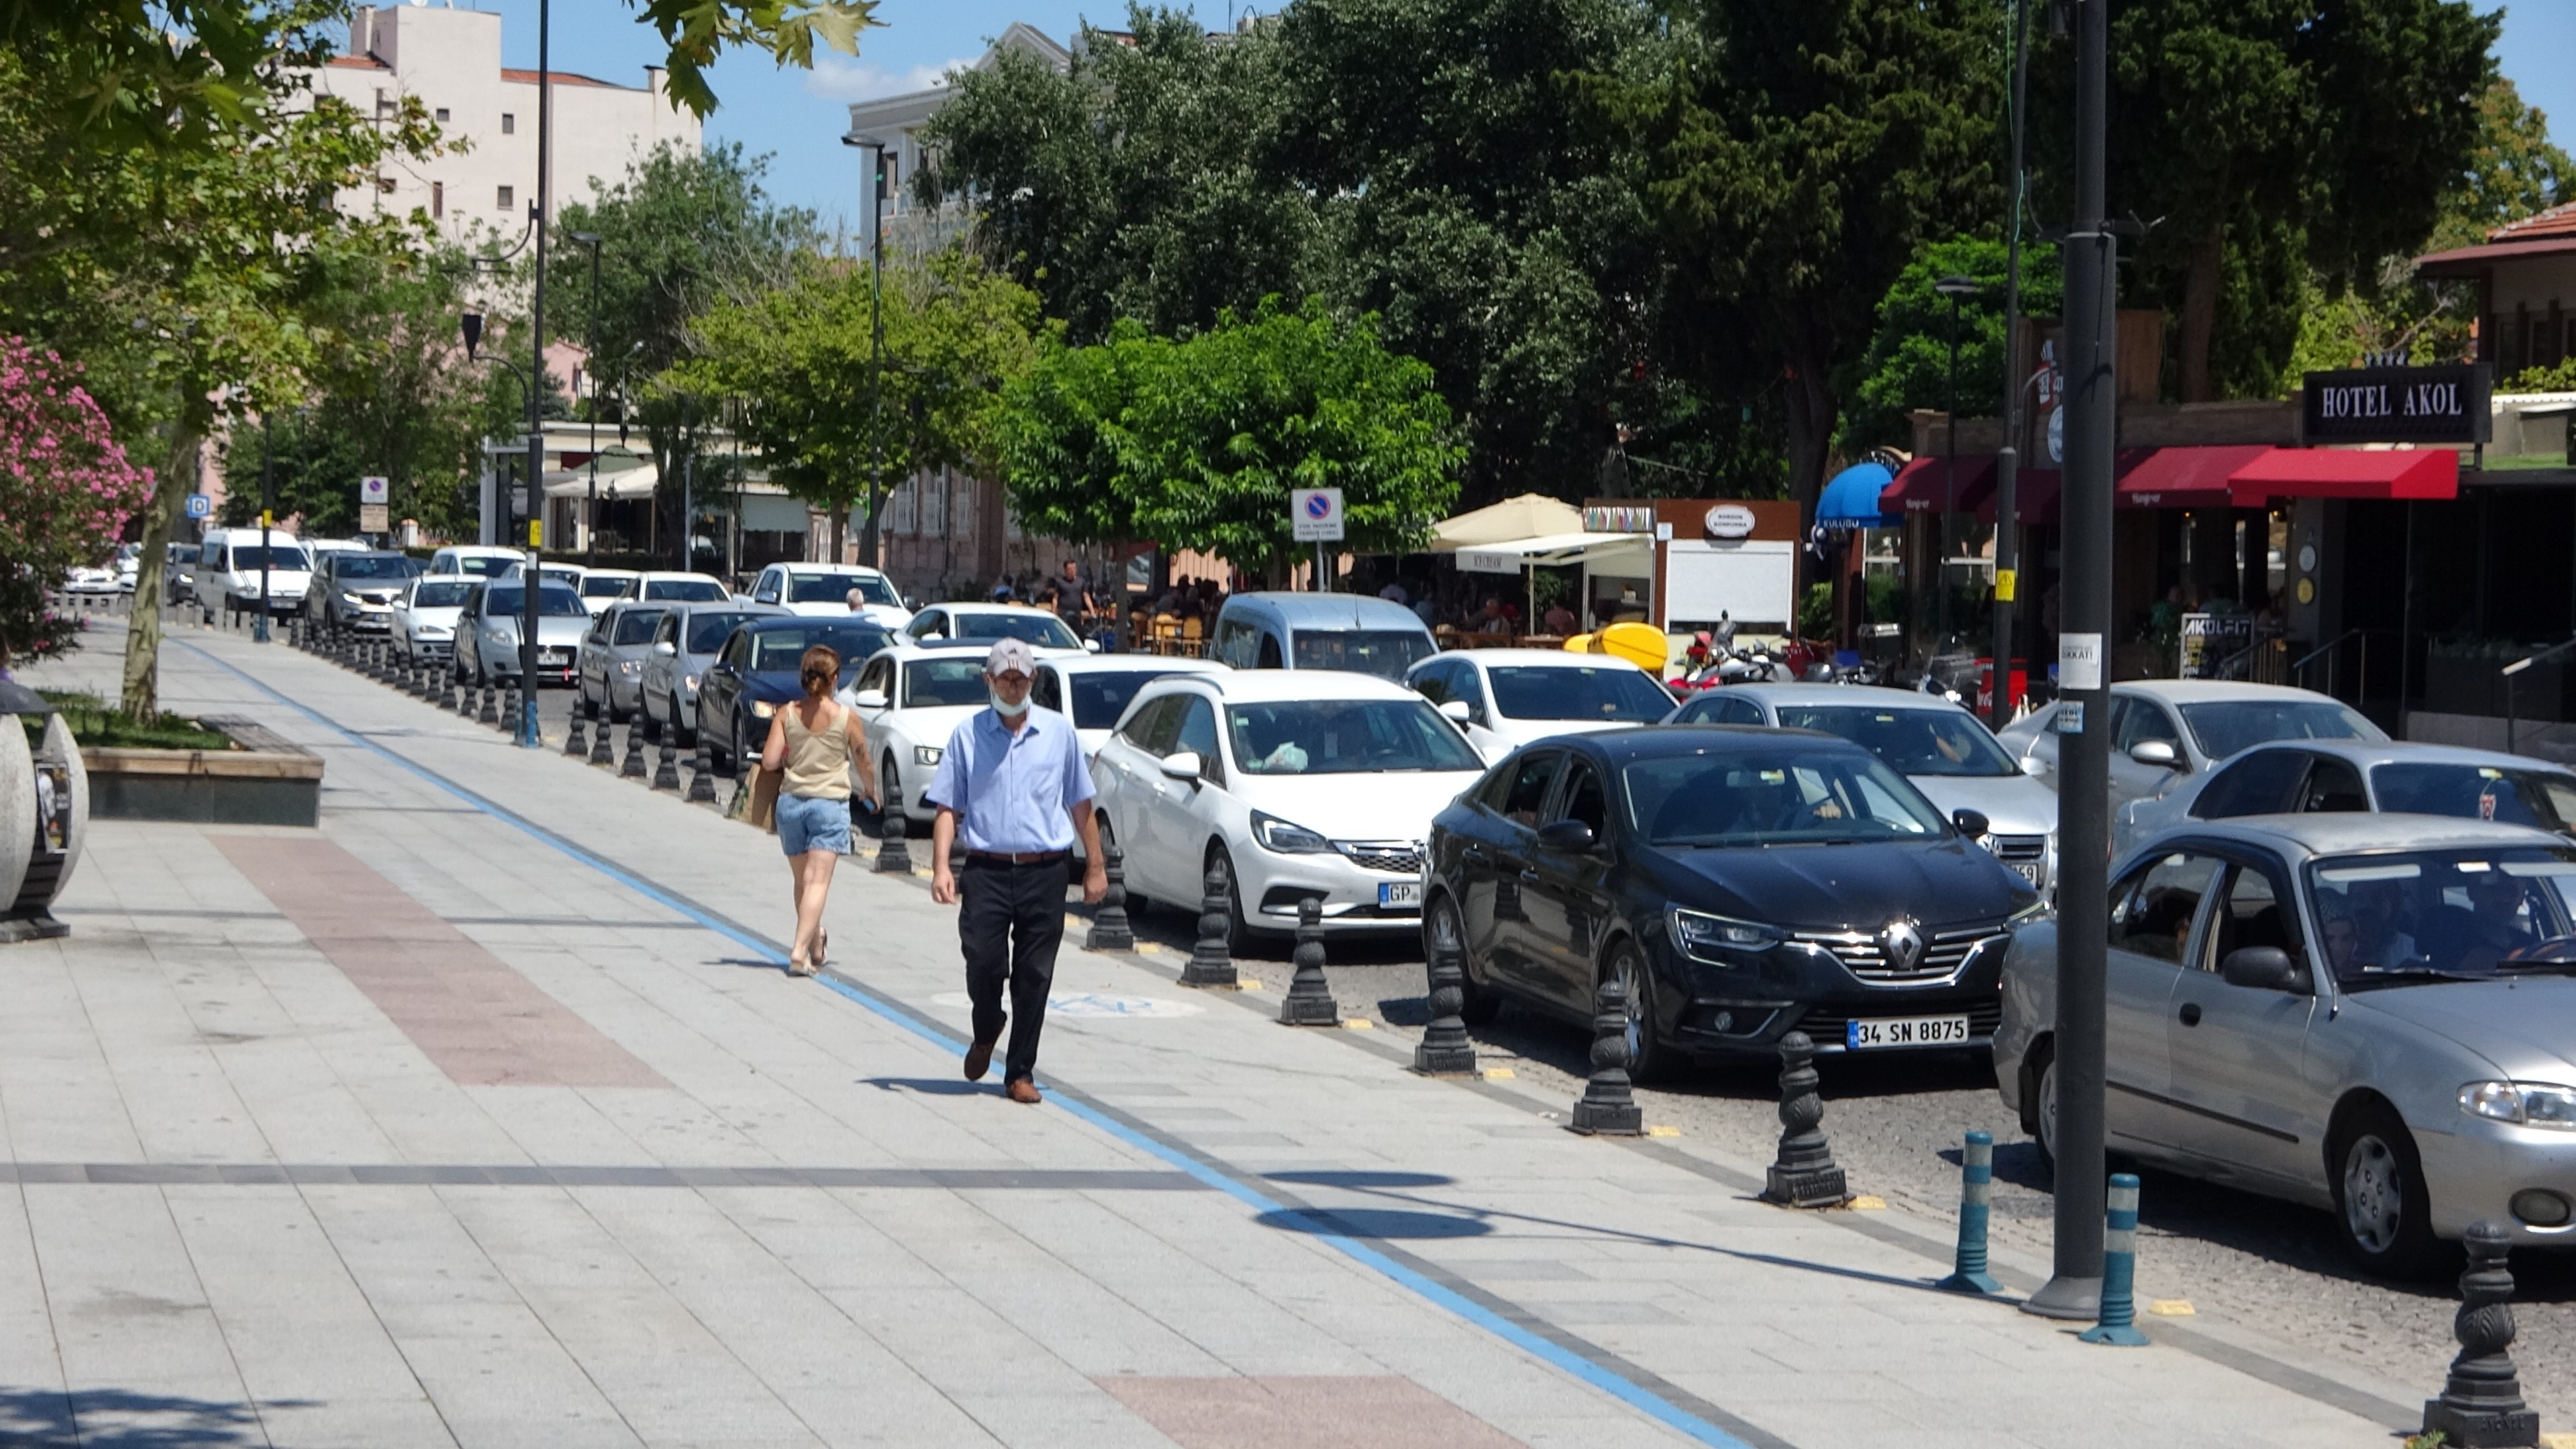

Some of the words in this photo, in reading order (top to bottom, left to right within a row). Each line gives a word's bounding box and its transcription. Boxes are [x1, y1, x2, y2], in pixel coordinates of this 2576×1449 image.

[2322, 385, 2392, 418] HOTEL
[2403, 383, 2462, 417] AKOL
[195, 500, 205, 512] D
[1390, 885, 1411, 901] GP
[1860, 1024, 1882, 1043] 34
[1890, 1022, 1912, 1042] SN
[1919, 1020, 1965, 1040] 8875
